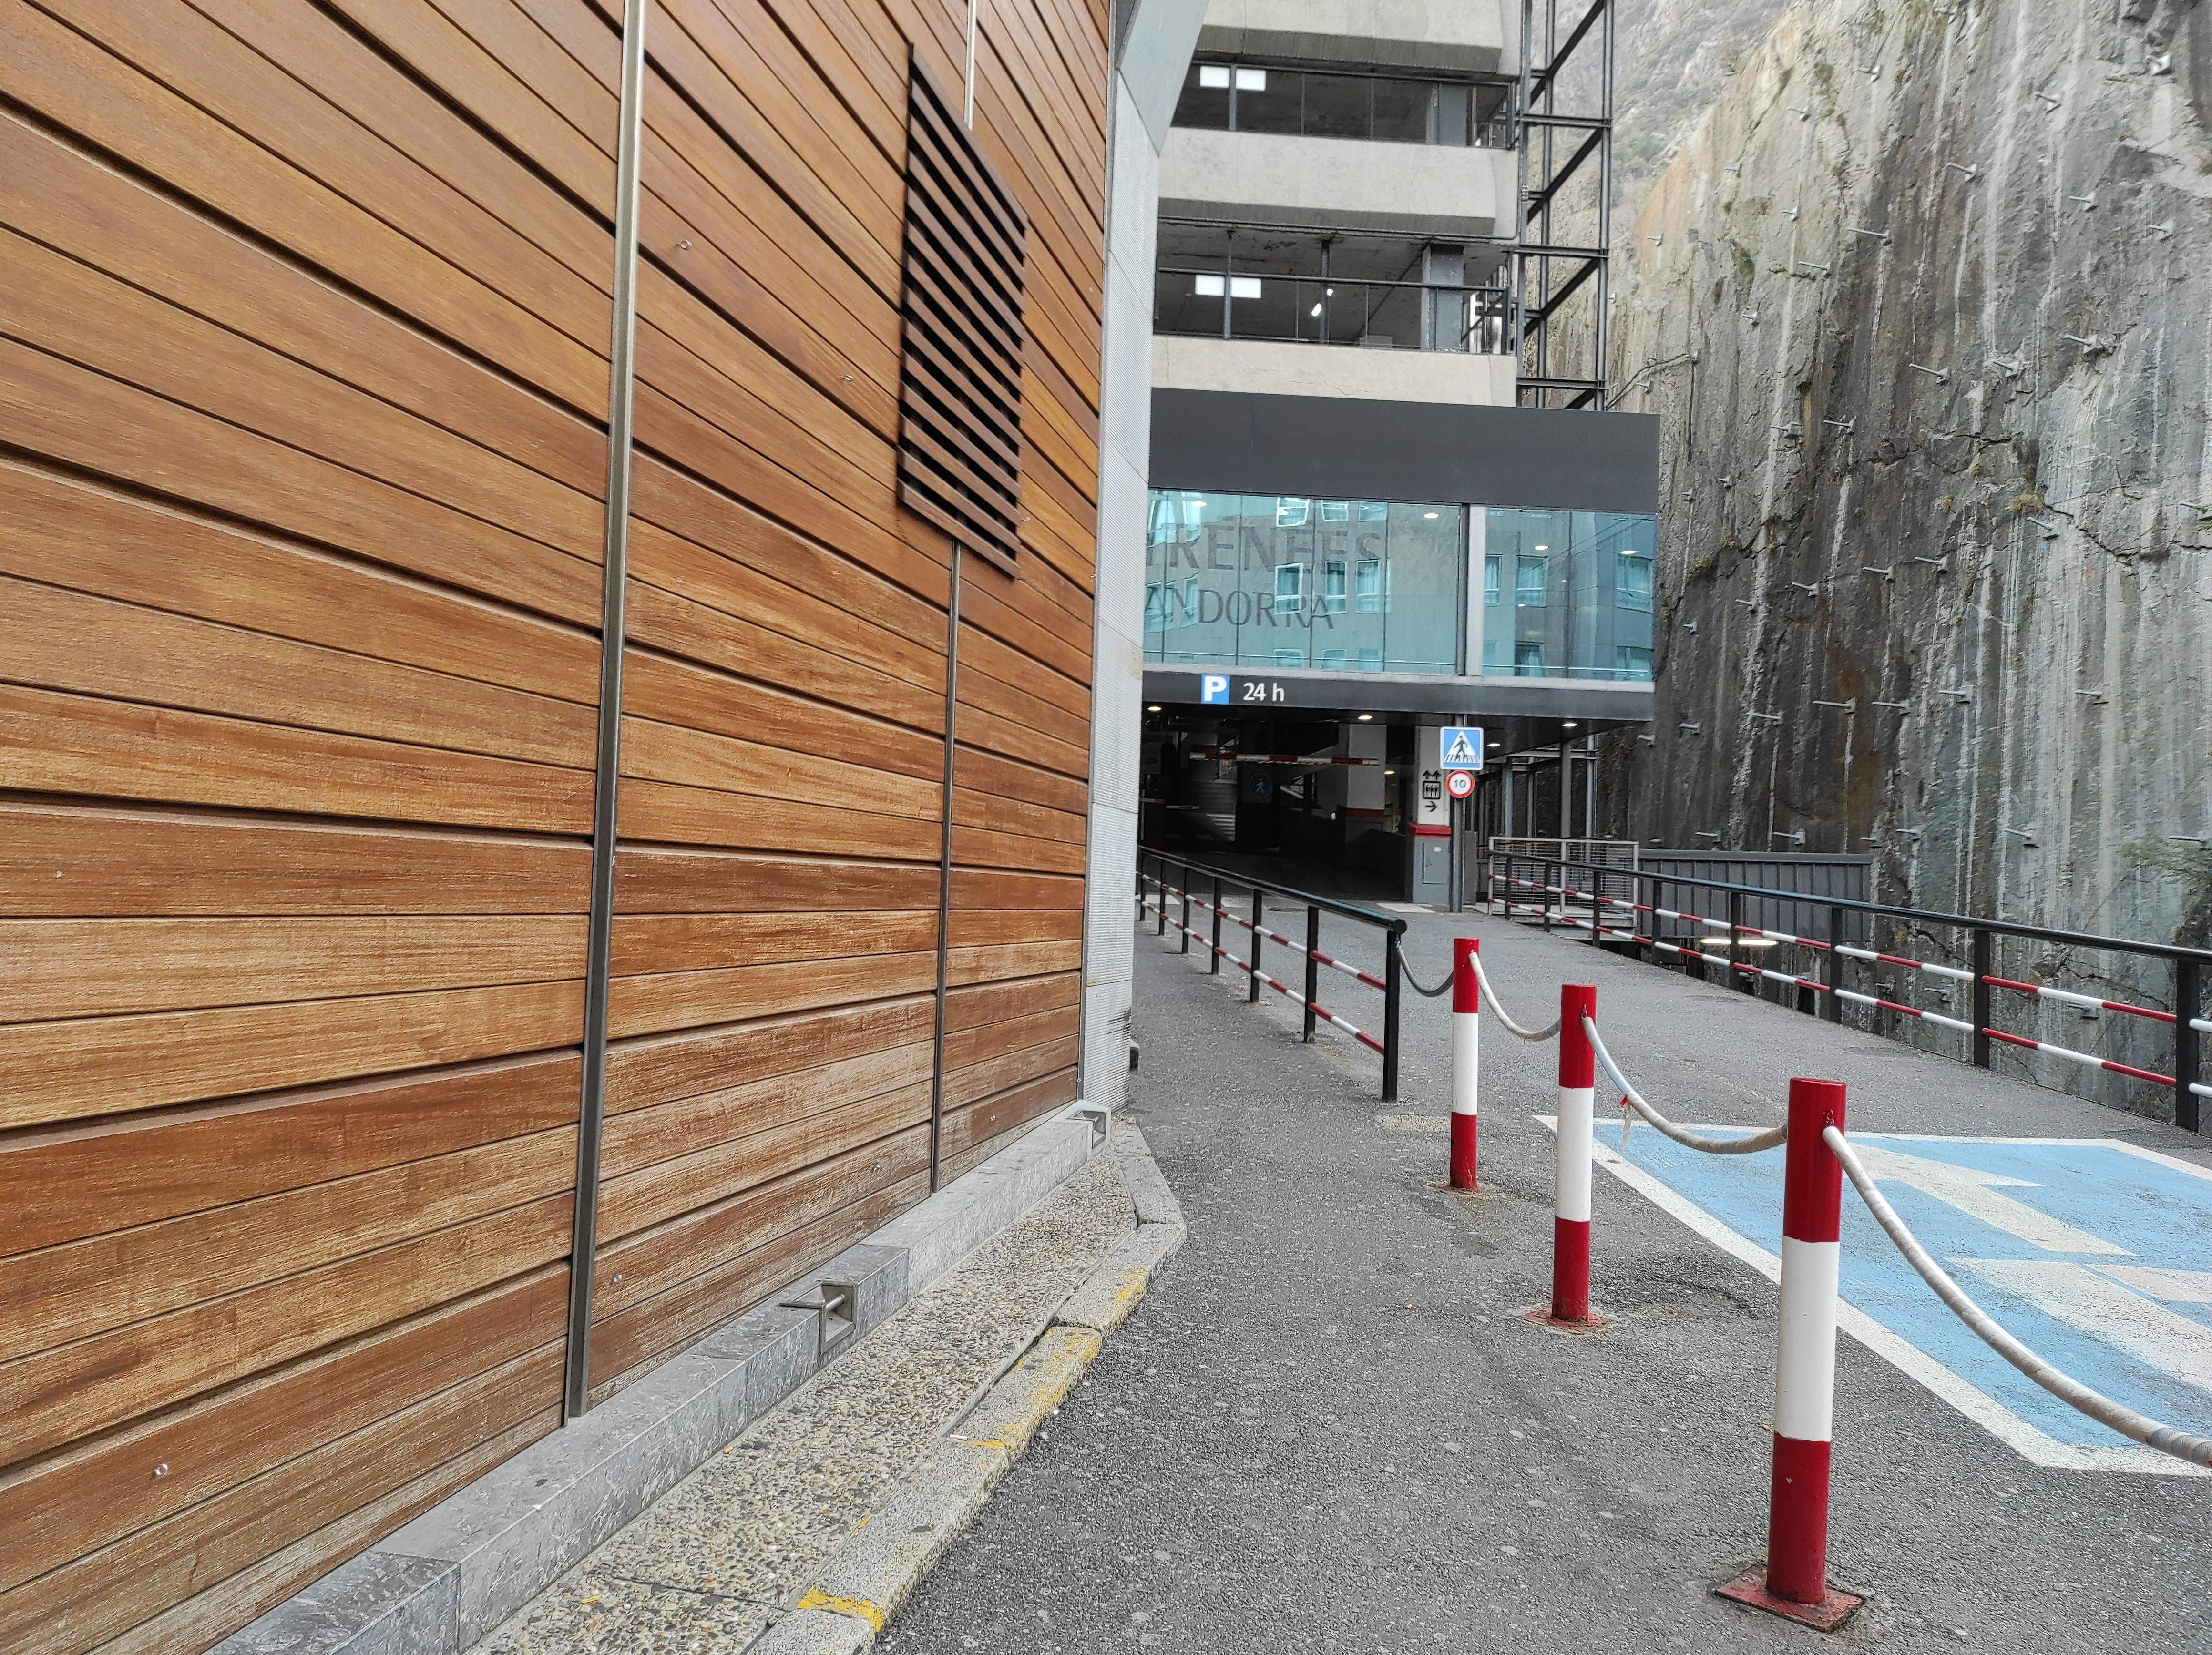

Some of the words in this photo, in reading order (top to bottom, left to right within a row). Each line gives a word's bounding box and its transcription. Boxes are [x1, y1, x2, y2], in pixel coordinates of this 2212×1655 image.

[1204, 675, 1227, 702] P
[1243, 682, 1267, 701] 24
[1272, 682, 1285, 702] h
[1454, 779, 1466, 788] 10
